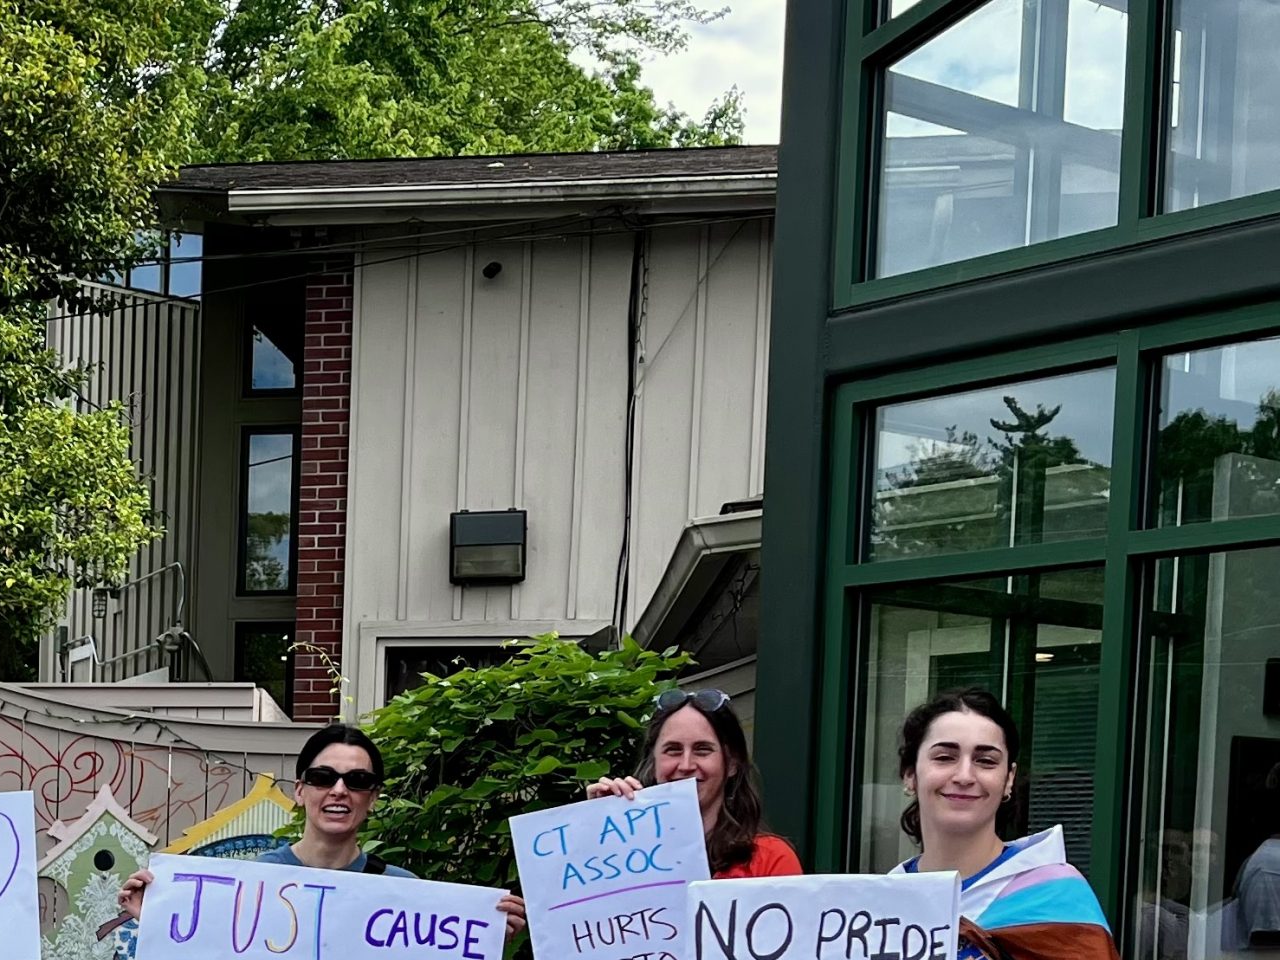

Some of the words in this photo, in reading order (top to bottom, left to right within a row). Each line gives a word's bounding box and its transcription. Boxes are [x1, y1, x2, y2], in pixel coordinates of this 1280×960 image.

[532, 825, 571, 858] CT
[600, 801, 675, 839] APT.
[561, 843, 681, 889] ASSOC.
[365, 908, 489, 960] CAUSE
[572, 907, 678, 954] HURTS
